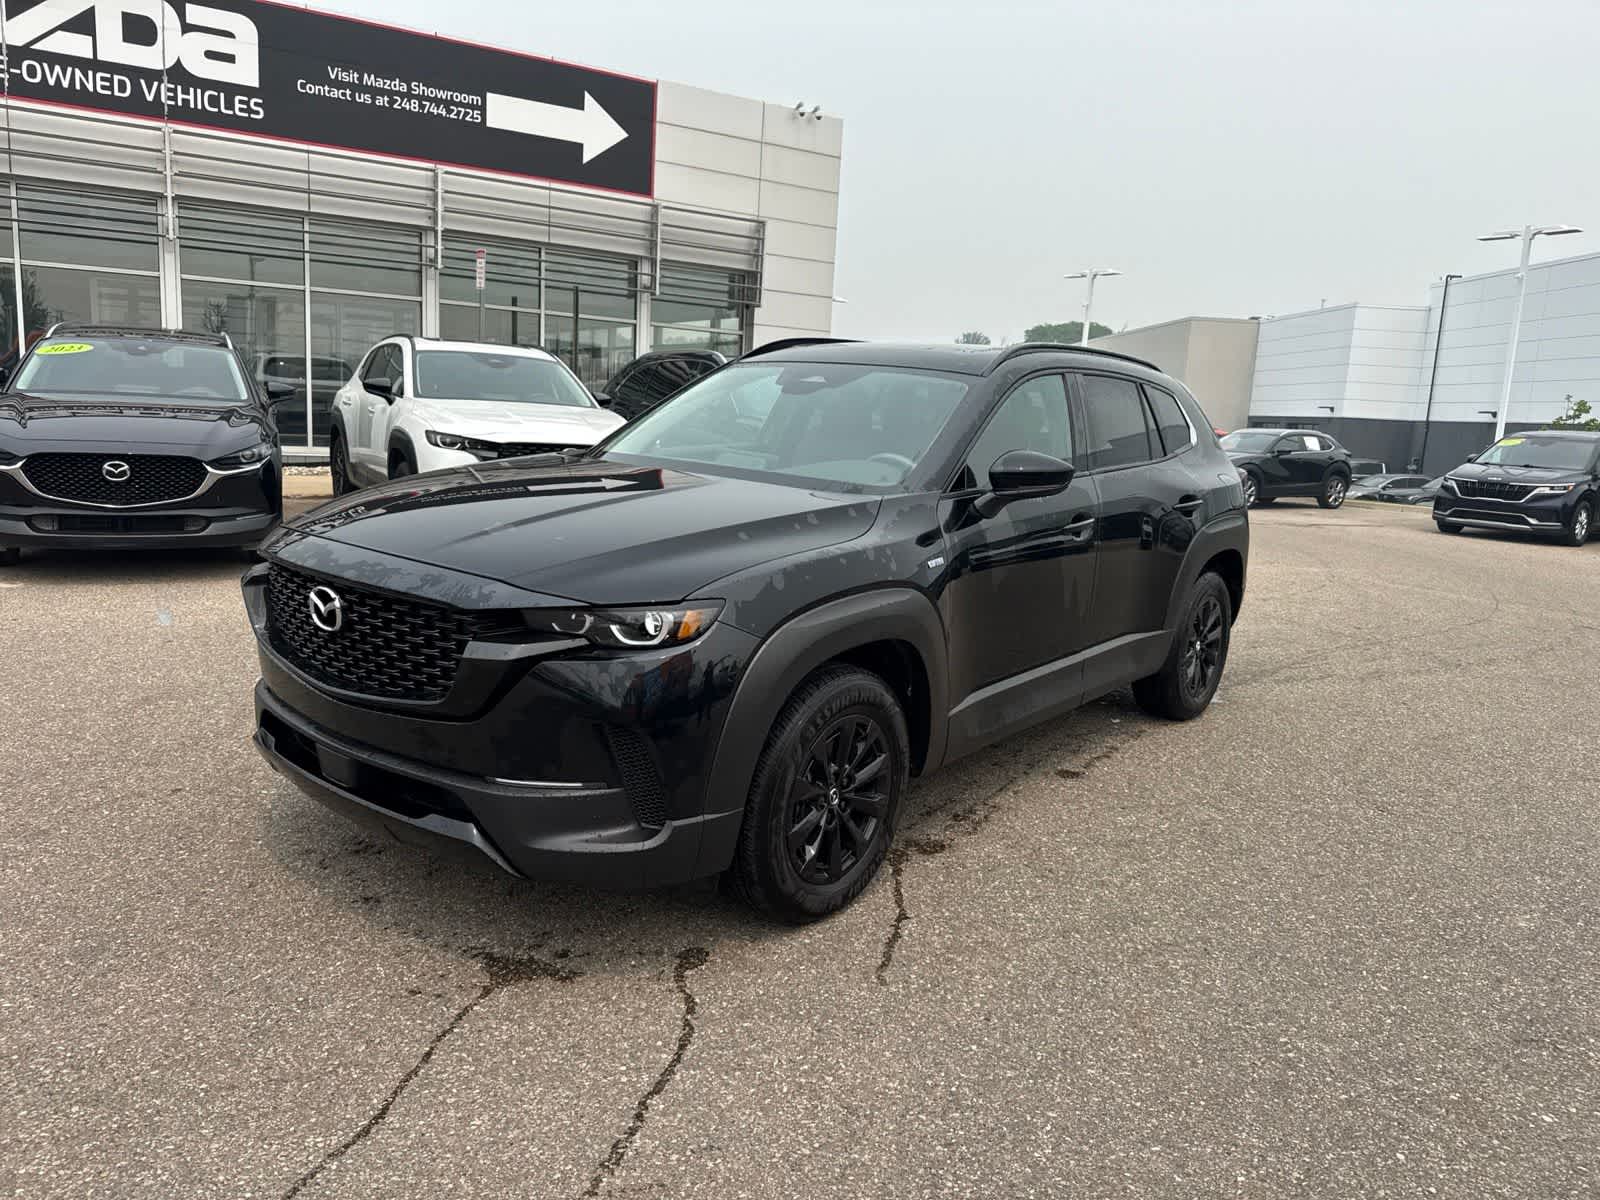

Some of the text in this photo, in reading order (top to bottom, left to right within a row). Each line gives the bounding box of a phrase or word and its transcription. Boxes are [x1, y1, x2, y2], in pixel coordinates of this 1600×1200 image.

[139, 78, 265, 120] VEHICLES
[297, 79, 482, 123] Contact us at 248.744.2725
[327, 65, 482, 106] Visit Mazda Showroom
